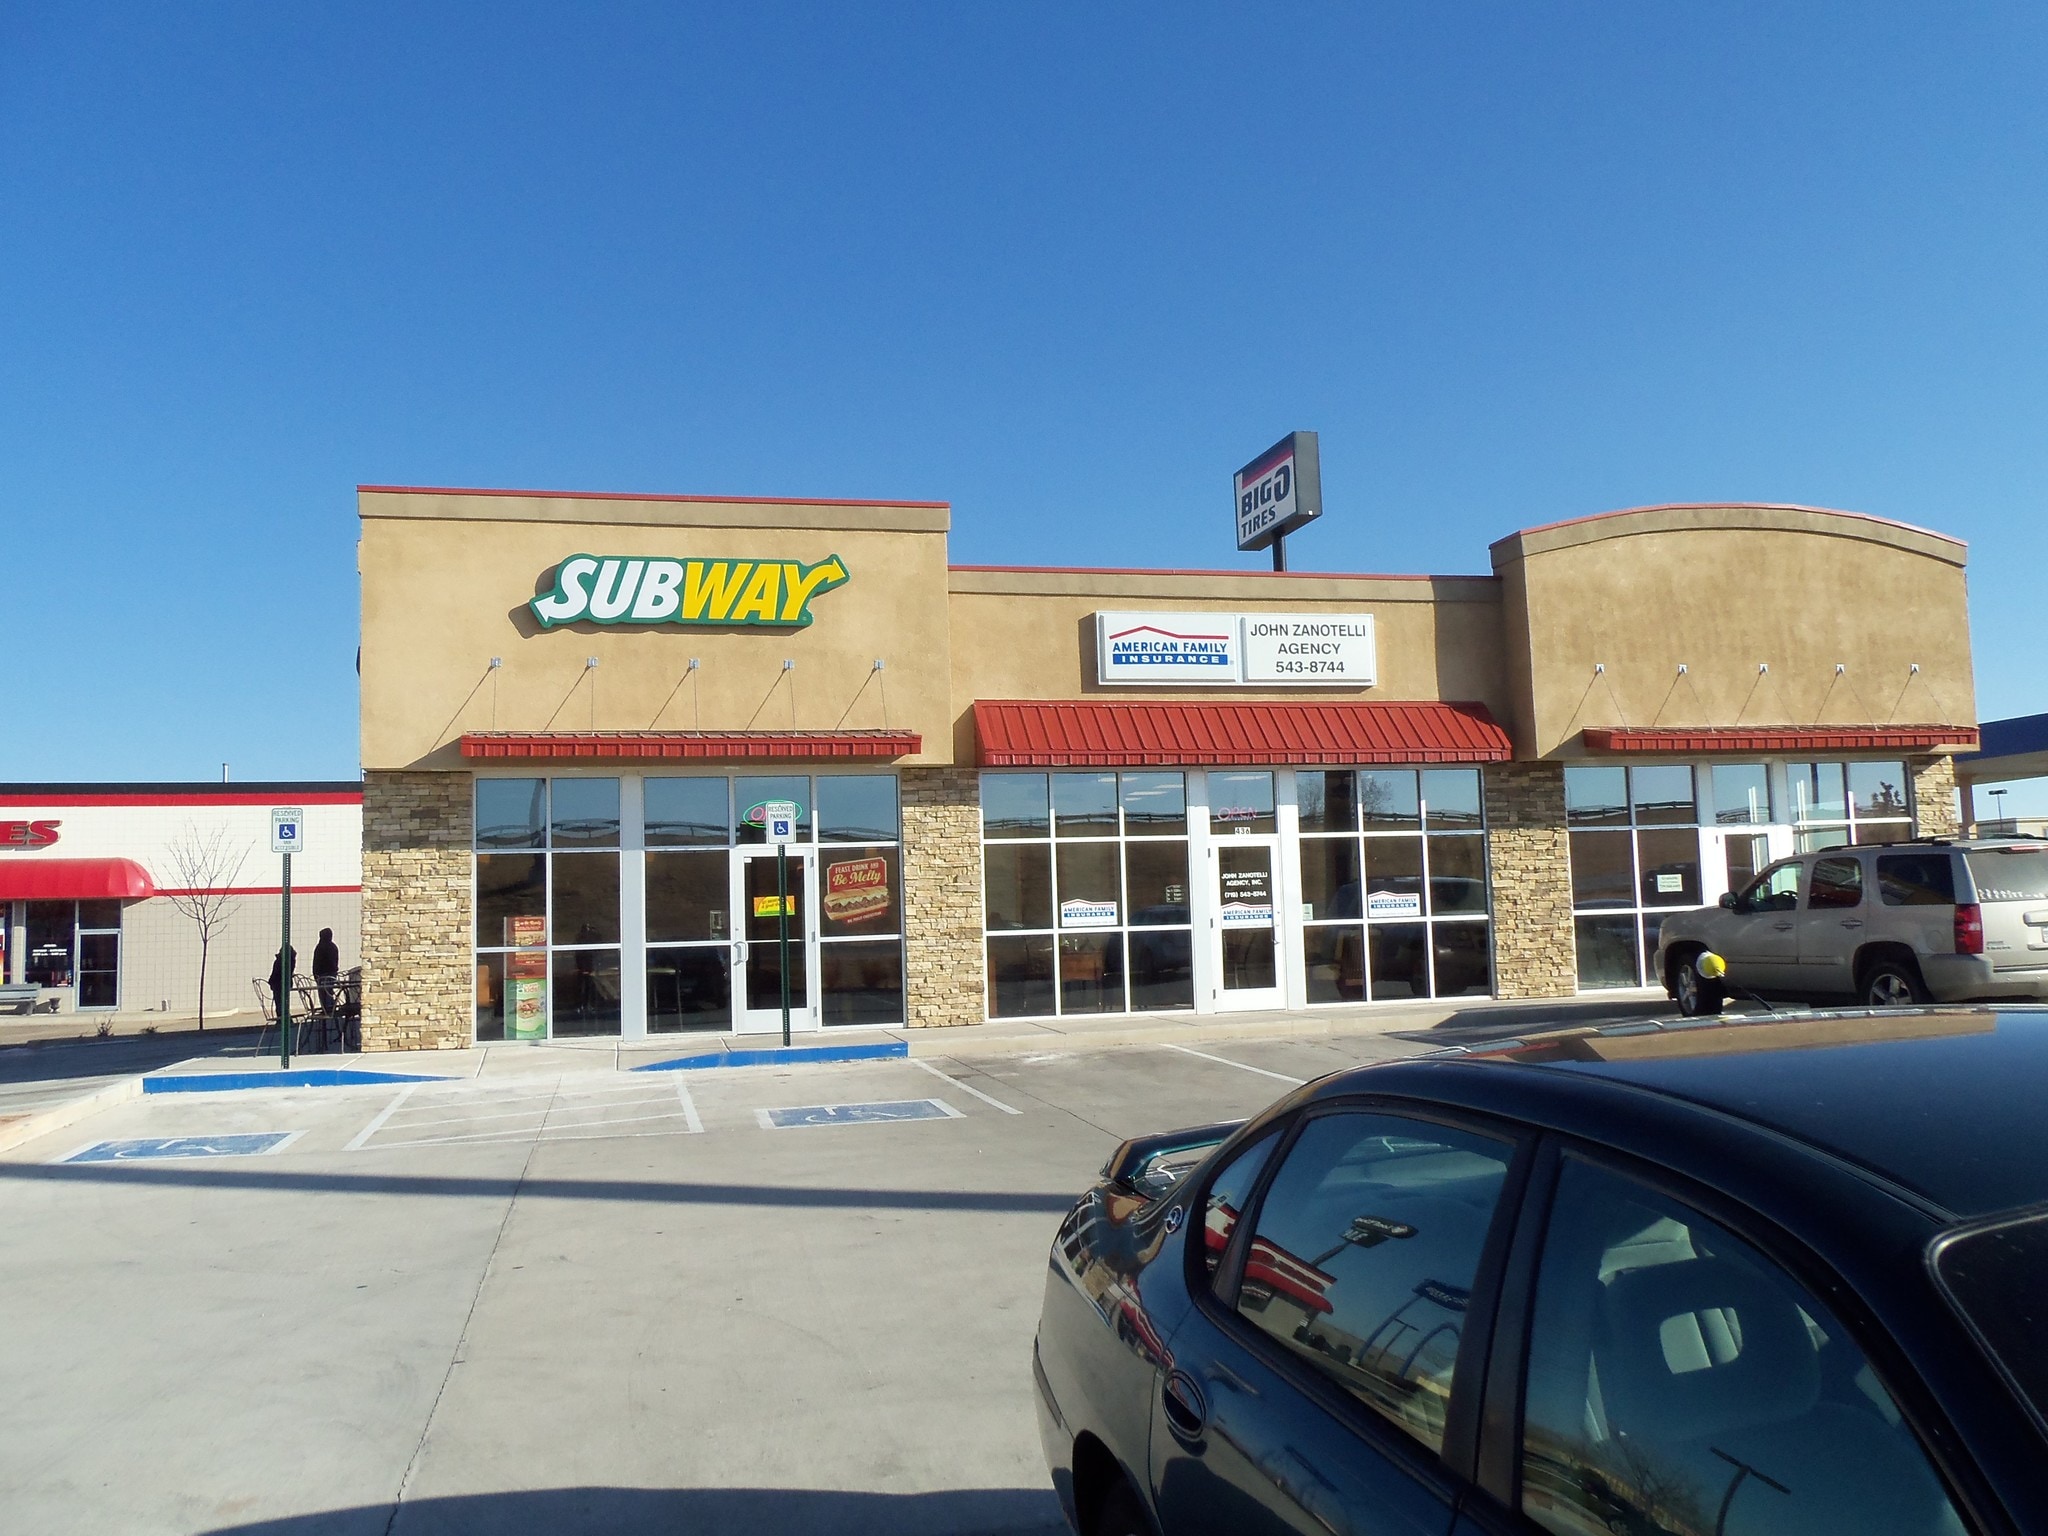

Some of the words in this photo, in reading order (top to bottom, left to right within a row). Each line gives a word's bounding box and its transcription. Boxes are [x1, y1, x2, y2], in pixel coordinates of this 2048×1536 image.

[1241, 504, 1276, 538] TIRES
[534, 558, 845, 621] SUBWAY
[1250, 623, 1289, 637] JOHN
[1292, 624, 1366, 637] ZANOTELLI
[1112, 642, 1178, 653] AMERICAN
[1183, 643, 1228, 653] FAMILY
[1278, 643, 1341, 655] AGENCY
[1121, 654, 1220, 664] INSURANCE
[1275, 661, 1345, 673] 543-8744
[1218, 807, 1257, 820] OPEN
[832, 873, 848, 886] Be
